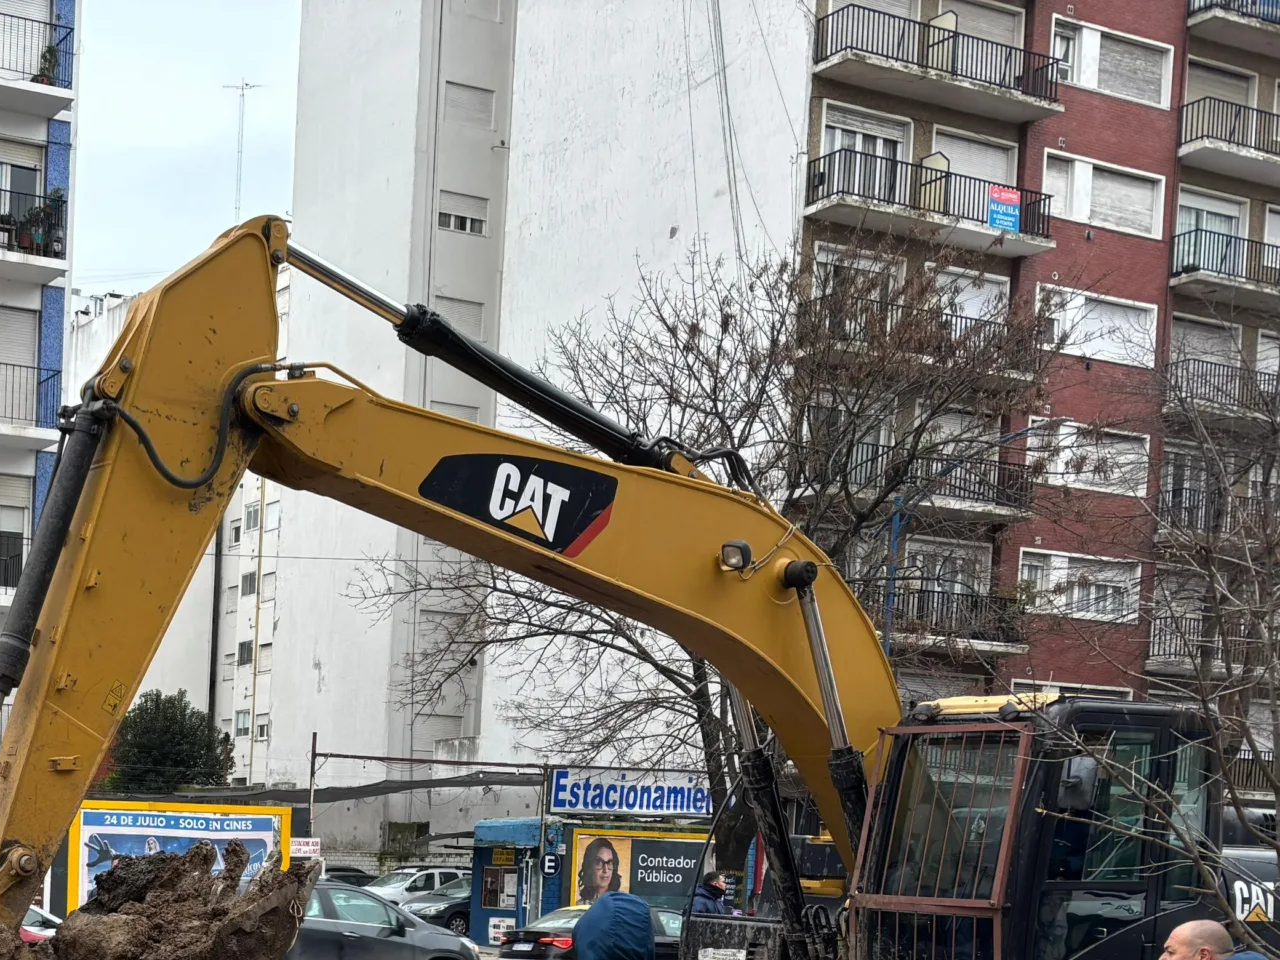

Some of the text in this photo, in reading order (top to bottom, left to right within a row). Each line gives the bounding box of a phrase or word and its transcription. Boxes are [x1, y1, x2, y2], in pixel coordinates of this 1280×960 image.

[990, 202, 1020, 216] ALQUILA
[489, 462, 570, 543] CAT
[104, 815, 253, 830] 24 DE JULIO SOLO EN CINES
[544, 855, 555, 873] E
[638, 853, 697, 869] Contador
[637, 868, 683, 883] Público
[1233, 879, 1275, 922] CAT
